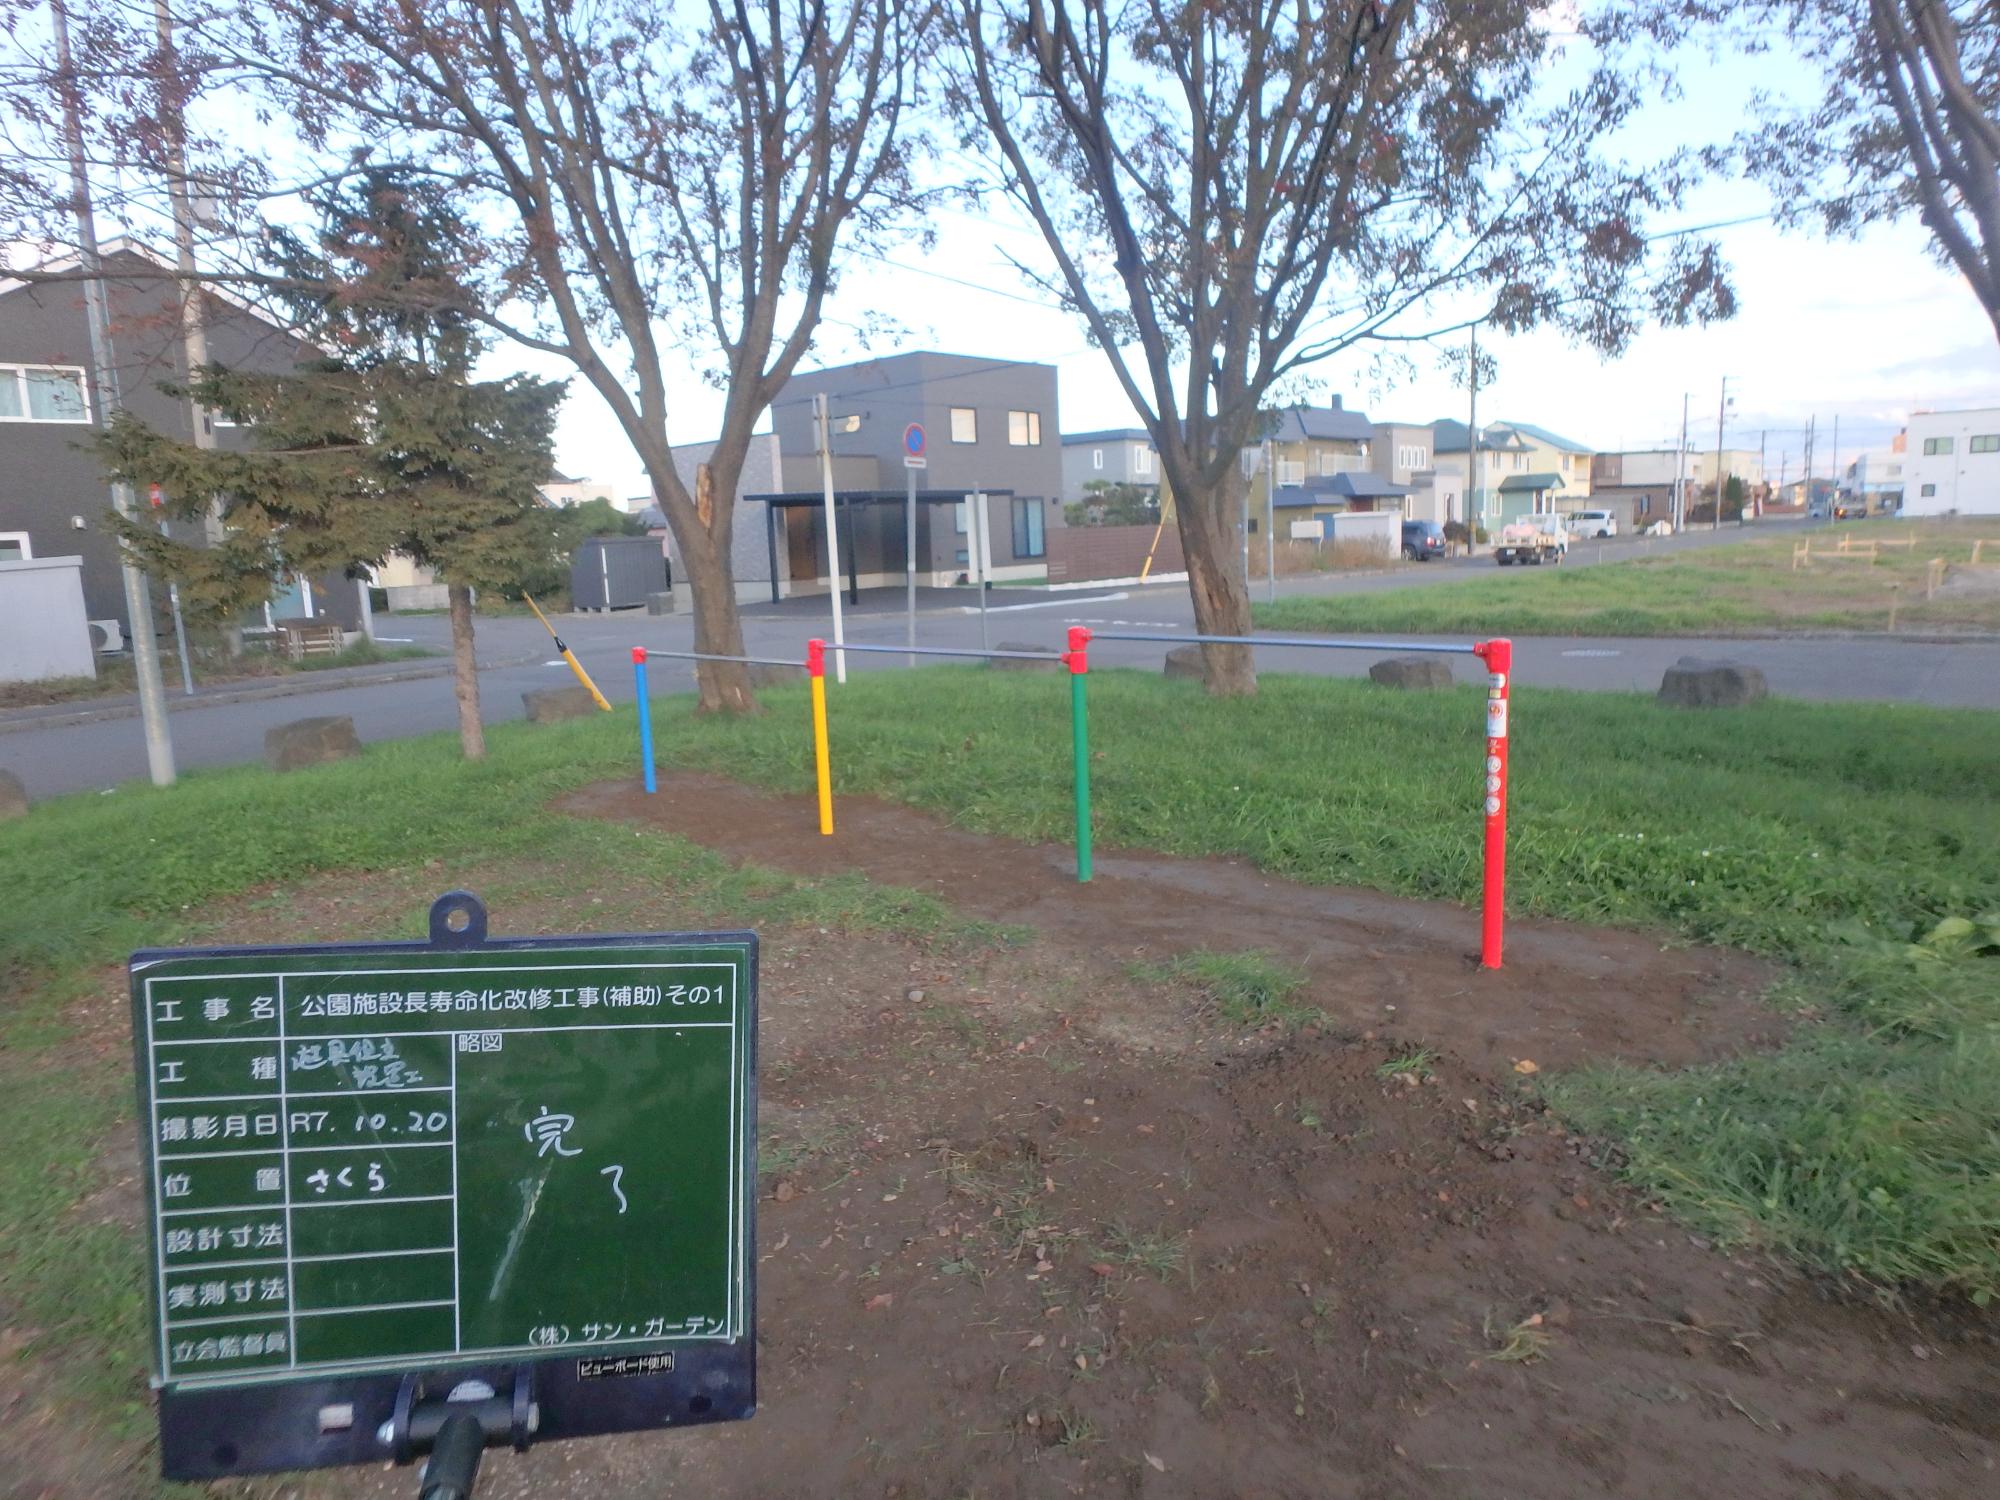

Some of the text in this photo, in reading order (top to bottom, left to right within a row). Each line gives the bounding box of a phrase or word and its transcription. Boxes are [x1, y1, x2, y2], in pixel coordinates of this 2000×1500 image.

[156, 996, 275, 1022] 工事名
[300, 984, 724, 1017] 公園施設長寿命化改修工事(補助)その1
[458, 1033, 503, 1053] 略図
[158, 1056, 277, 1083] 工種
[160, 1114, 277, 1141] 撮影月日
[164, 1167, 281, 1197] 位置
[306, 1162, 386, 1194] さくら
[165, 1223, 283, 1254] 設計寸法
[167, 1277, 286, 1310] 実測寸法
[171, 1330, 287, 1363] 立会監督員
